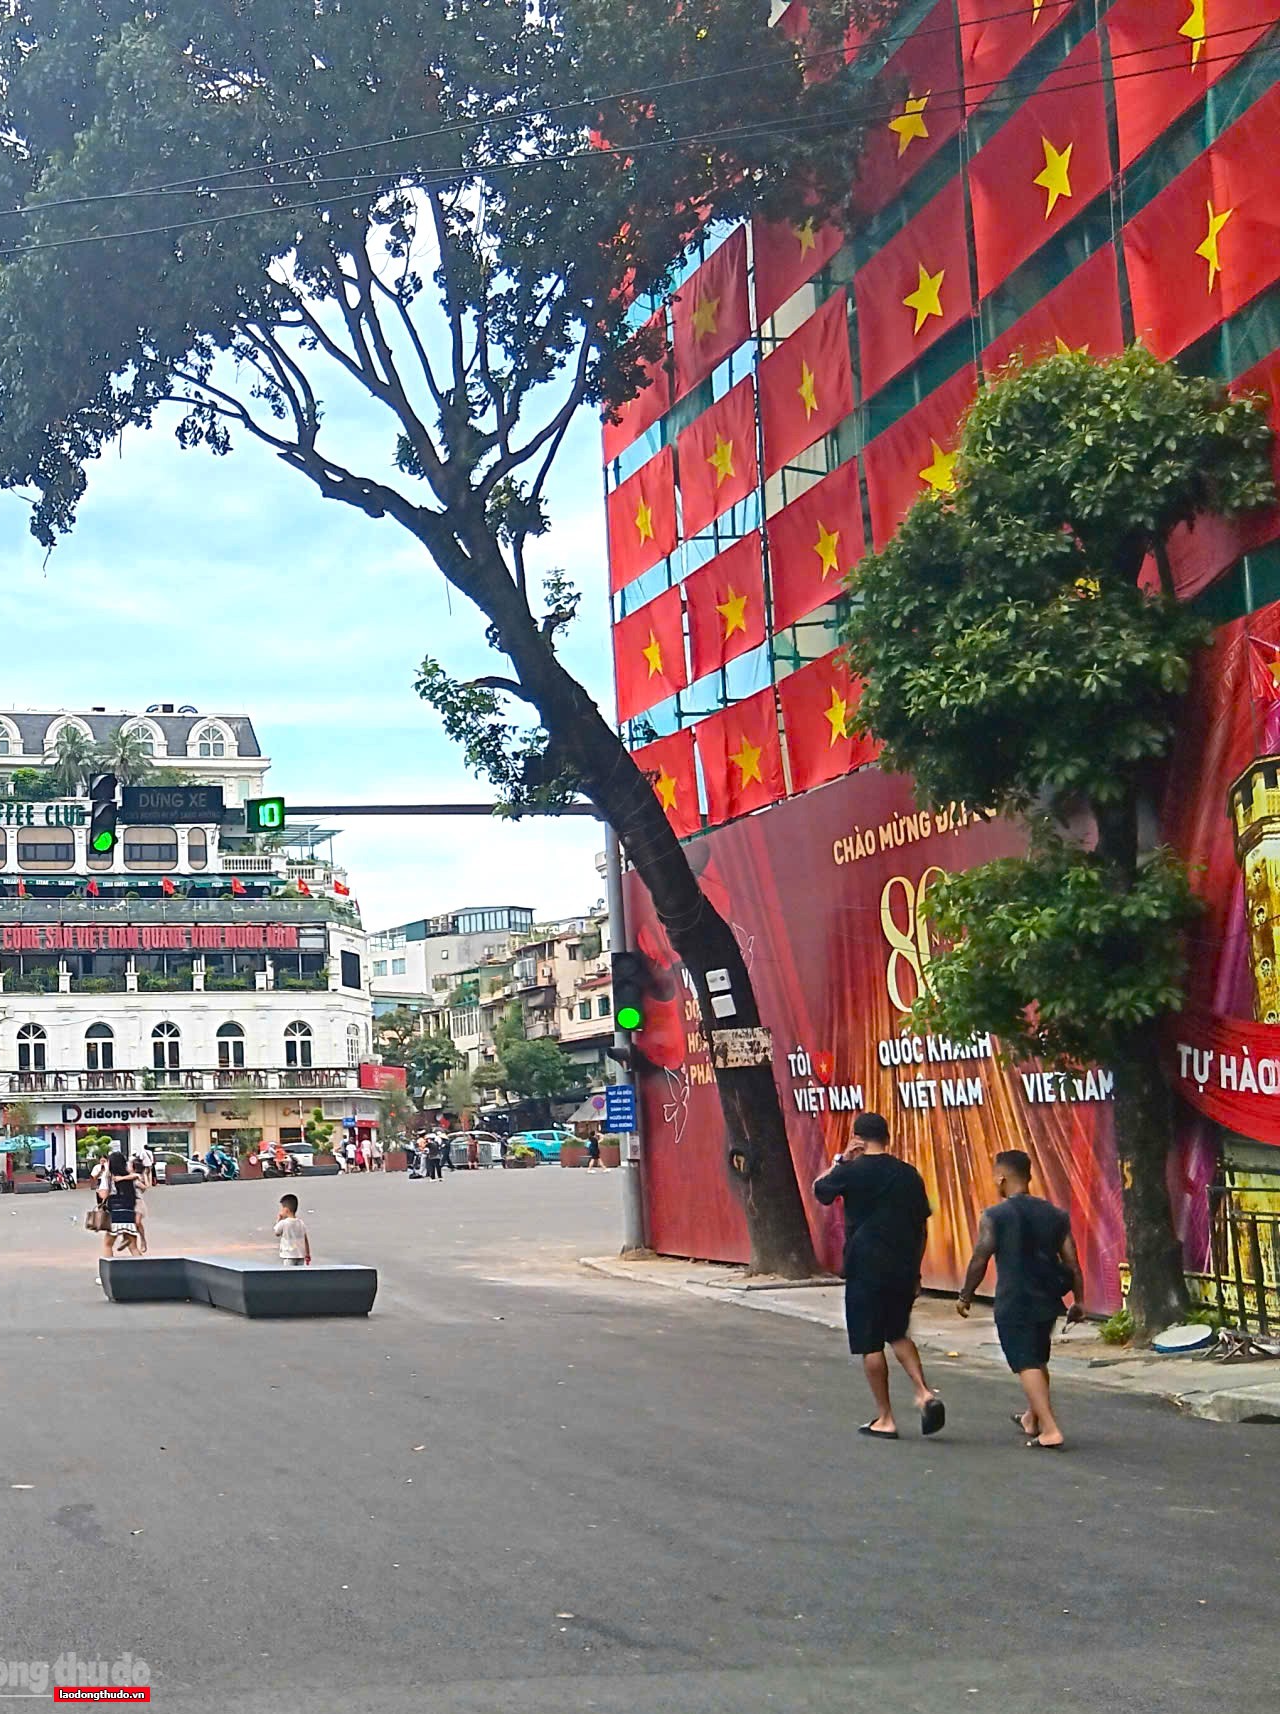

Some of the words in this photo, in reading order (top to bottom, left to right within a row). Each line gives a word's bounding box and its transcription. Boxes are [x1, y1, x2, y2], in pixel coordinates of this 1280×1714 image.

[45, 804, 86, 826] CLUB
[189, 793, 207, 807] XE
[258, 803, 280, 827] 10
[833, 825, 877, 865] CHÀO
[879, 811, 931, 851] MỪNG
[788, 1045, 812, 1078] TÔI
[878, 1028, 925, 1067] QUỐC
[1176, 1044, 1214, 1093] TỰ
[1220, 1045, 1277, 1096] HÀO
[84, 1107, 154, 1121] didongviet
[793, 1079, 825, 1119] VIỆT
[828, 1085, 864, 1112] NAM
[898, 1075, 938, 1117] VIỆT
[941, 1077, 984, 1107] NAM
